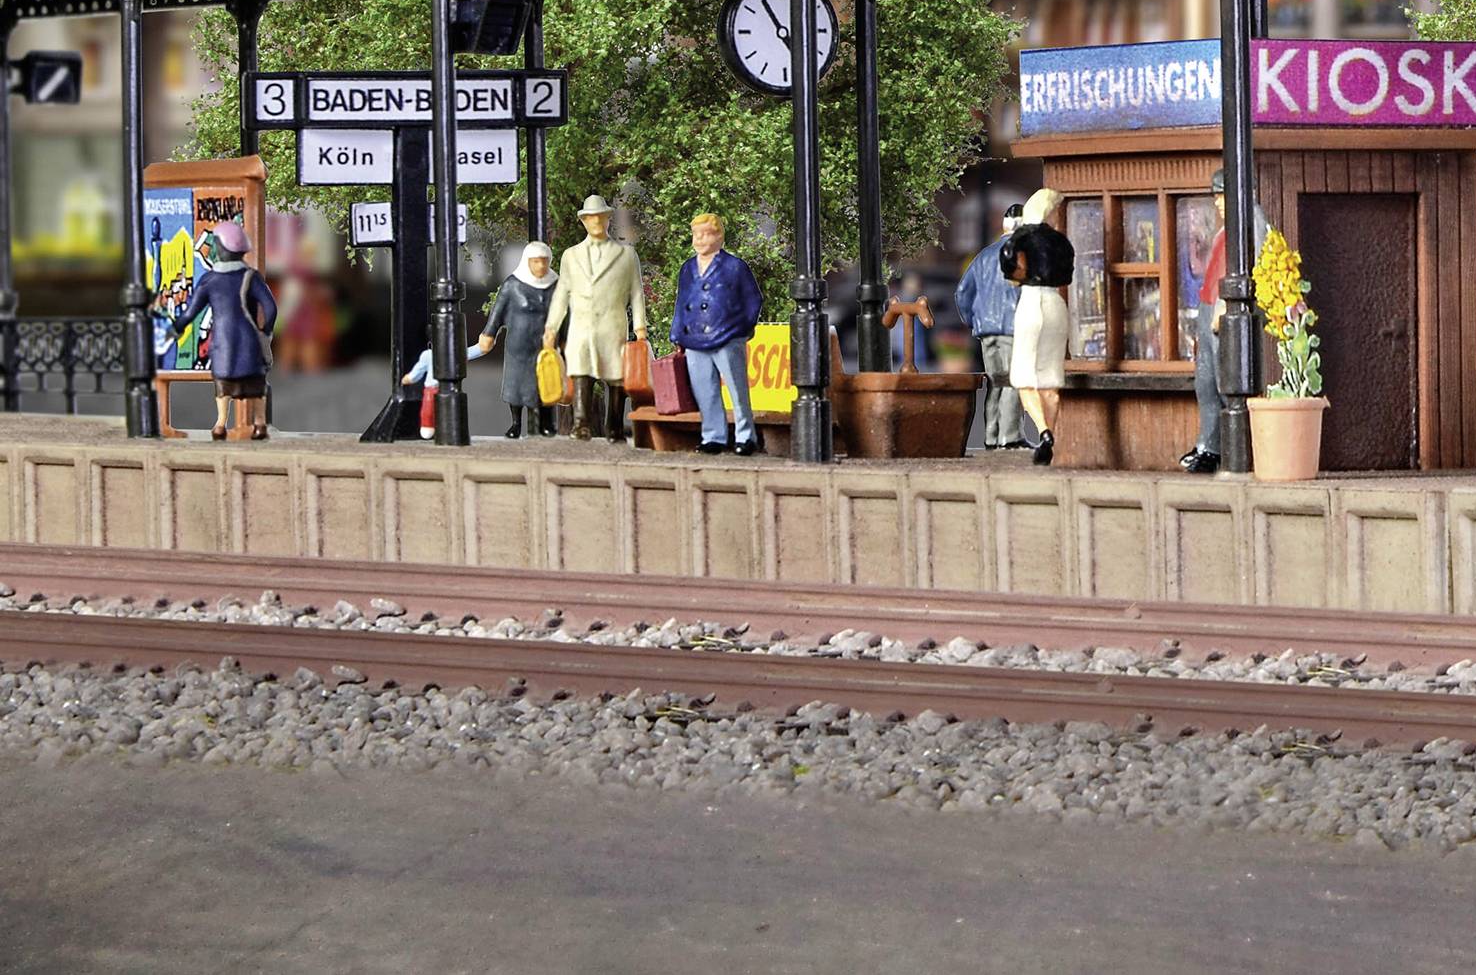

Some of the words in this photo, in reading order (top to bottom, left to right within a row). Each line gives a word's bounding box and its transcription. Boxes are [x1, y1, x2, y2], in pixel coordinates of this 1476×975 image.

[263, 83, 286, 115] 3
[532, 81, 553, 114] 2
[1020, 58, 1222, 113] ERFRISCHUNGEN
[312, 88, 508, 112] BADEN-BDEN
[318, 146, 374, 166] Köln
[457, 147, 502, 165] asel
